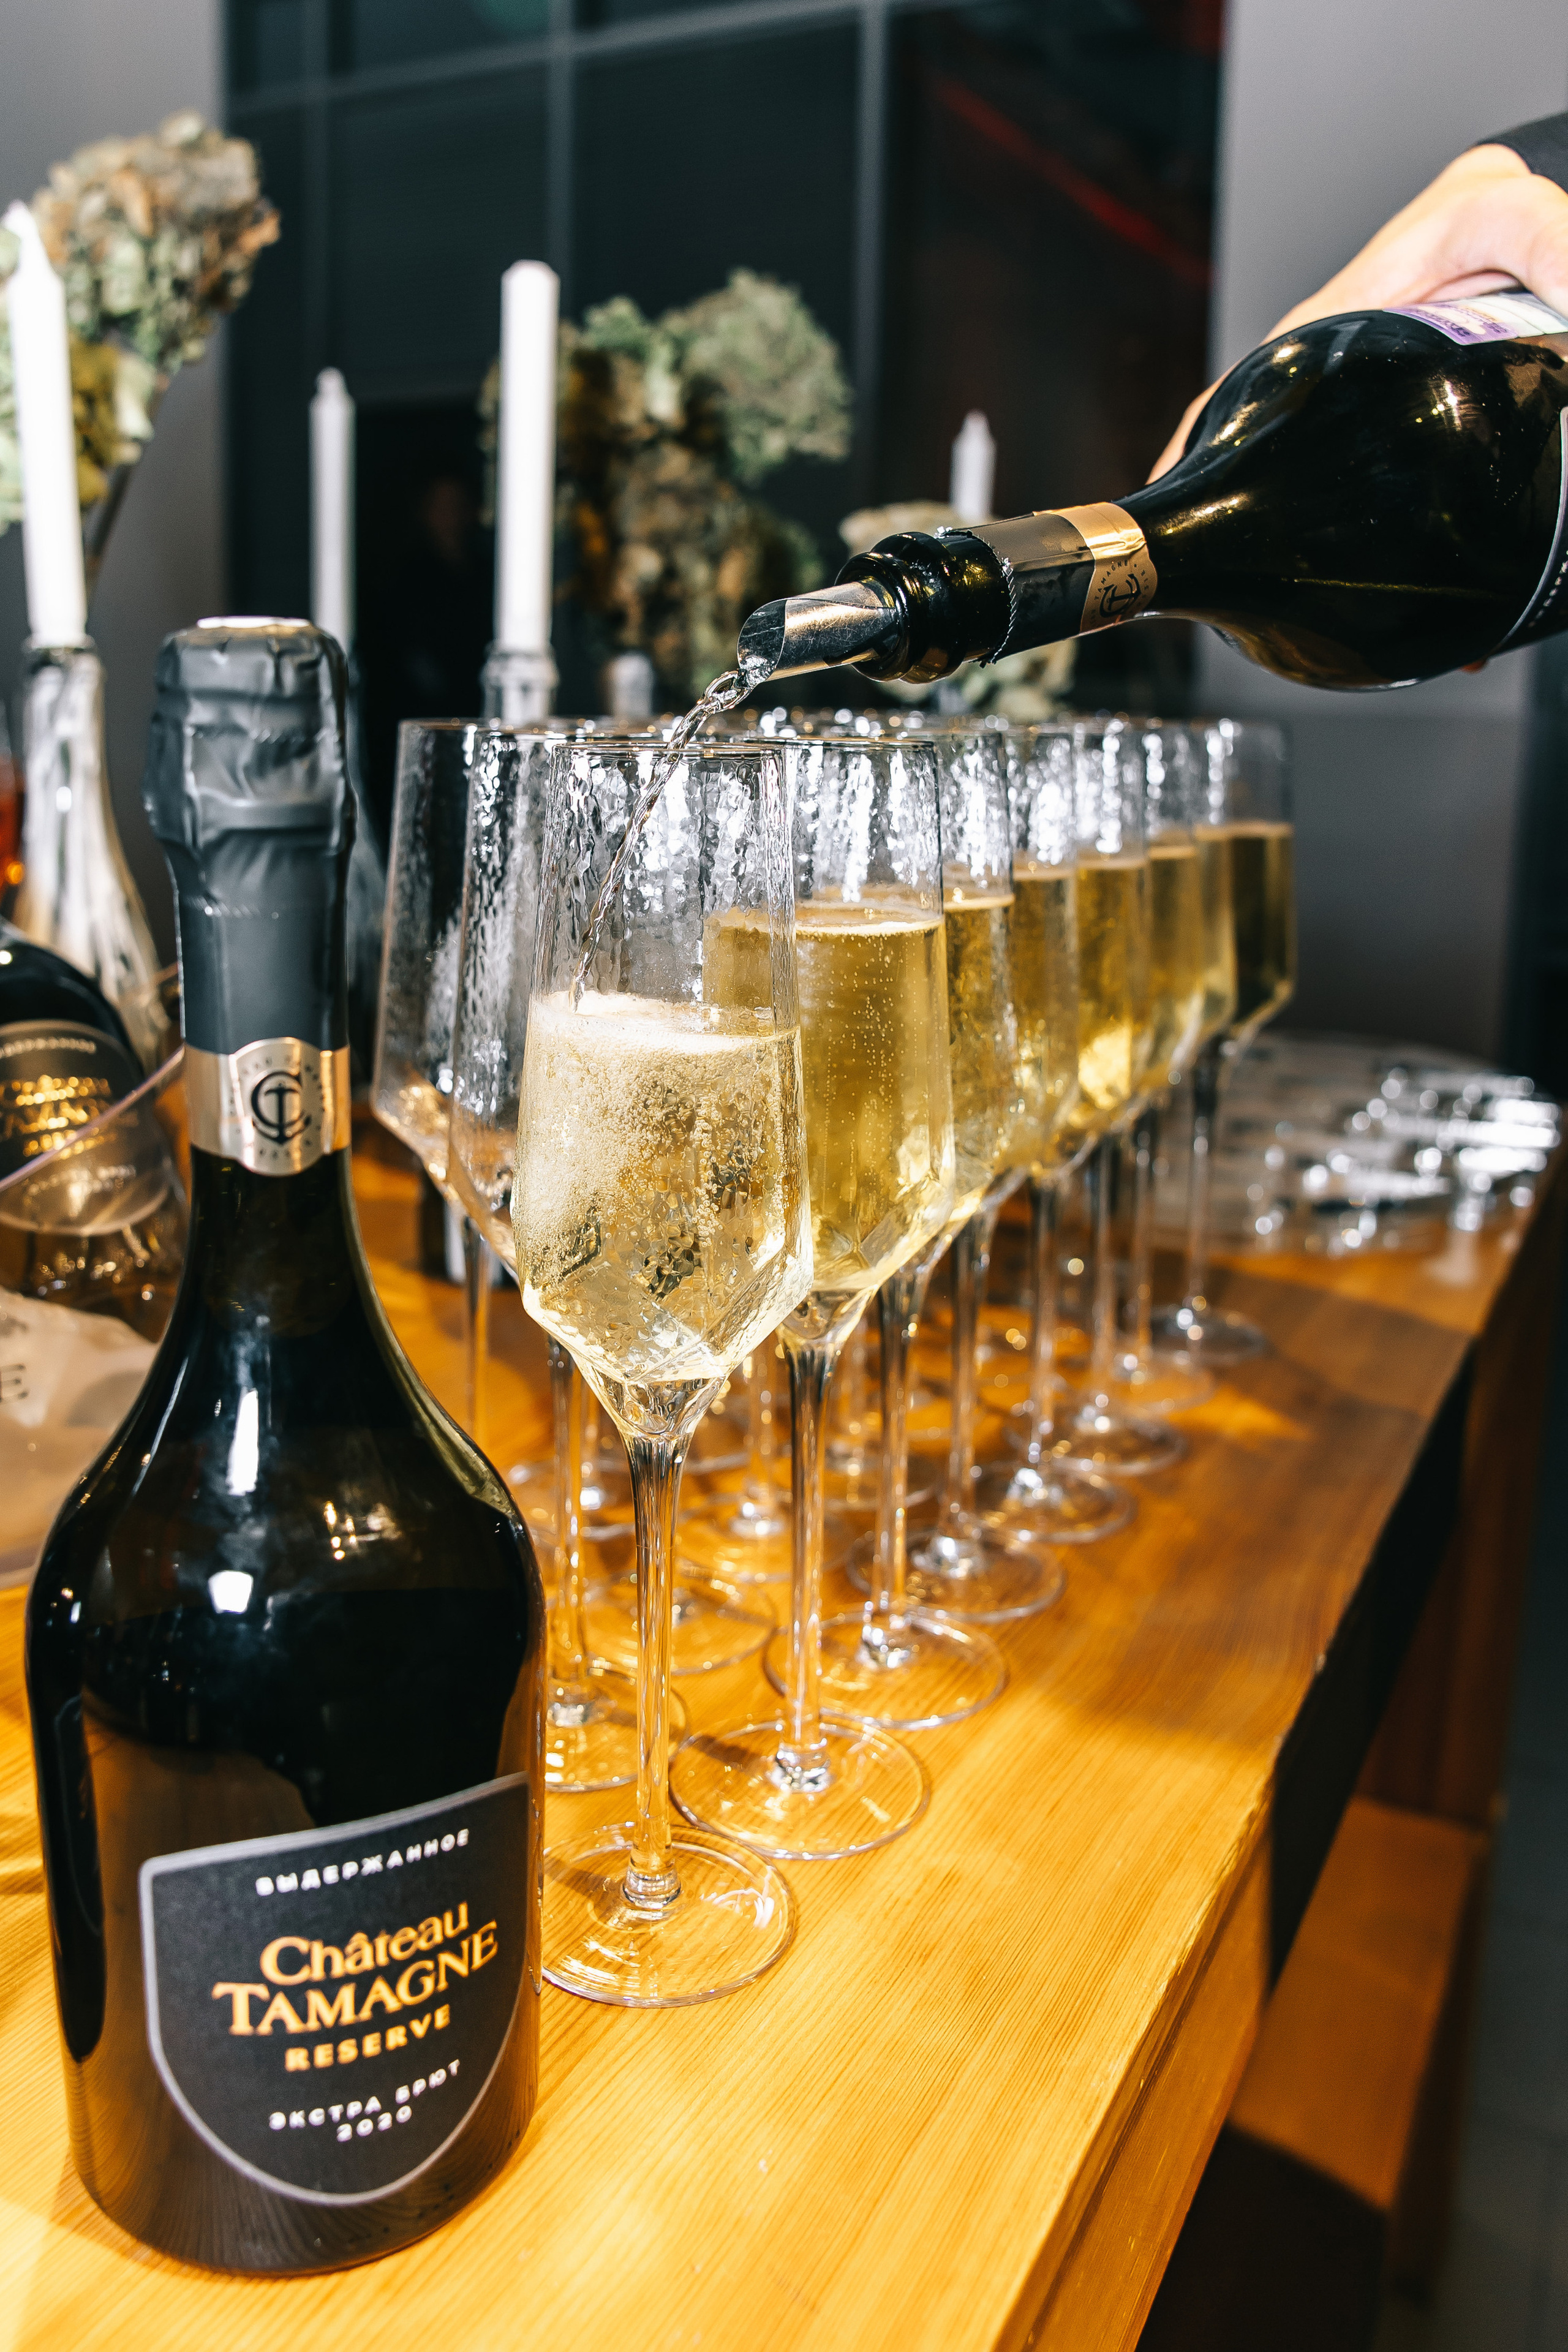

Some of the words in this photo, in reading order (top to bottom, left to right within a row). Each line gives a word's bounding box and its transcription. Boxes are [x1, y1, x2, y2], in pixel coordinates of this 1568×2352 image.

[1094, 560, 1128, 600] TAMAGNE
[255, 1828, 469, 1896] ВЫДЕРЖАННОЕ
[211, 1920, 499, 2036] TAMAGNE
[260, 1901, 469, 1986] Château
[285, 2003, 450, 2072] RESERVE
[269, 2096, 382, 2130] ЭКСТРА
[395, 2059, 460, 2104] БРЮТ
[337, 2105, 412, 2142] 2020
